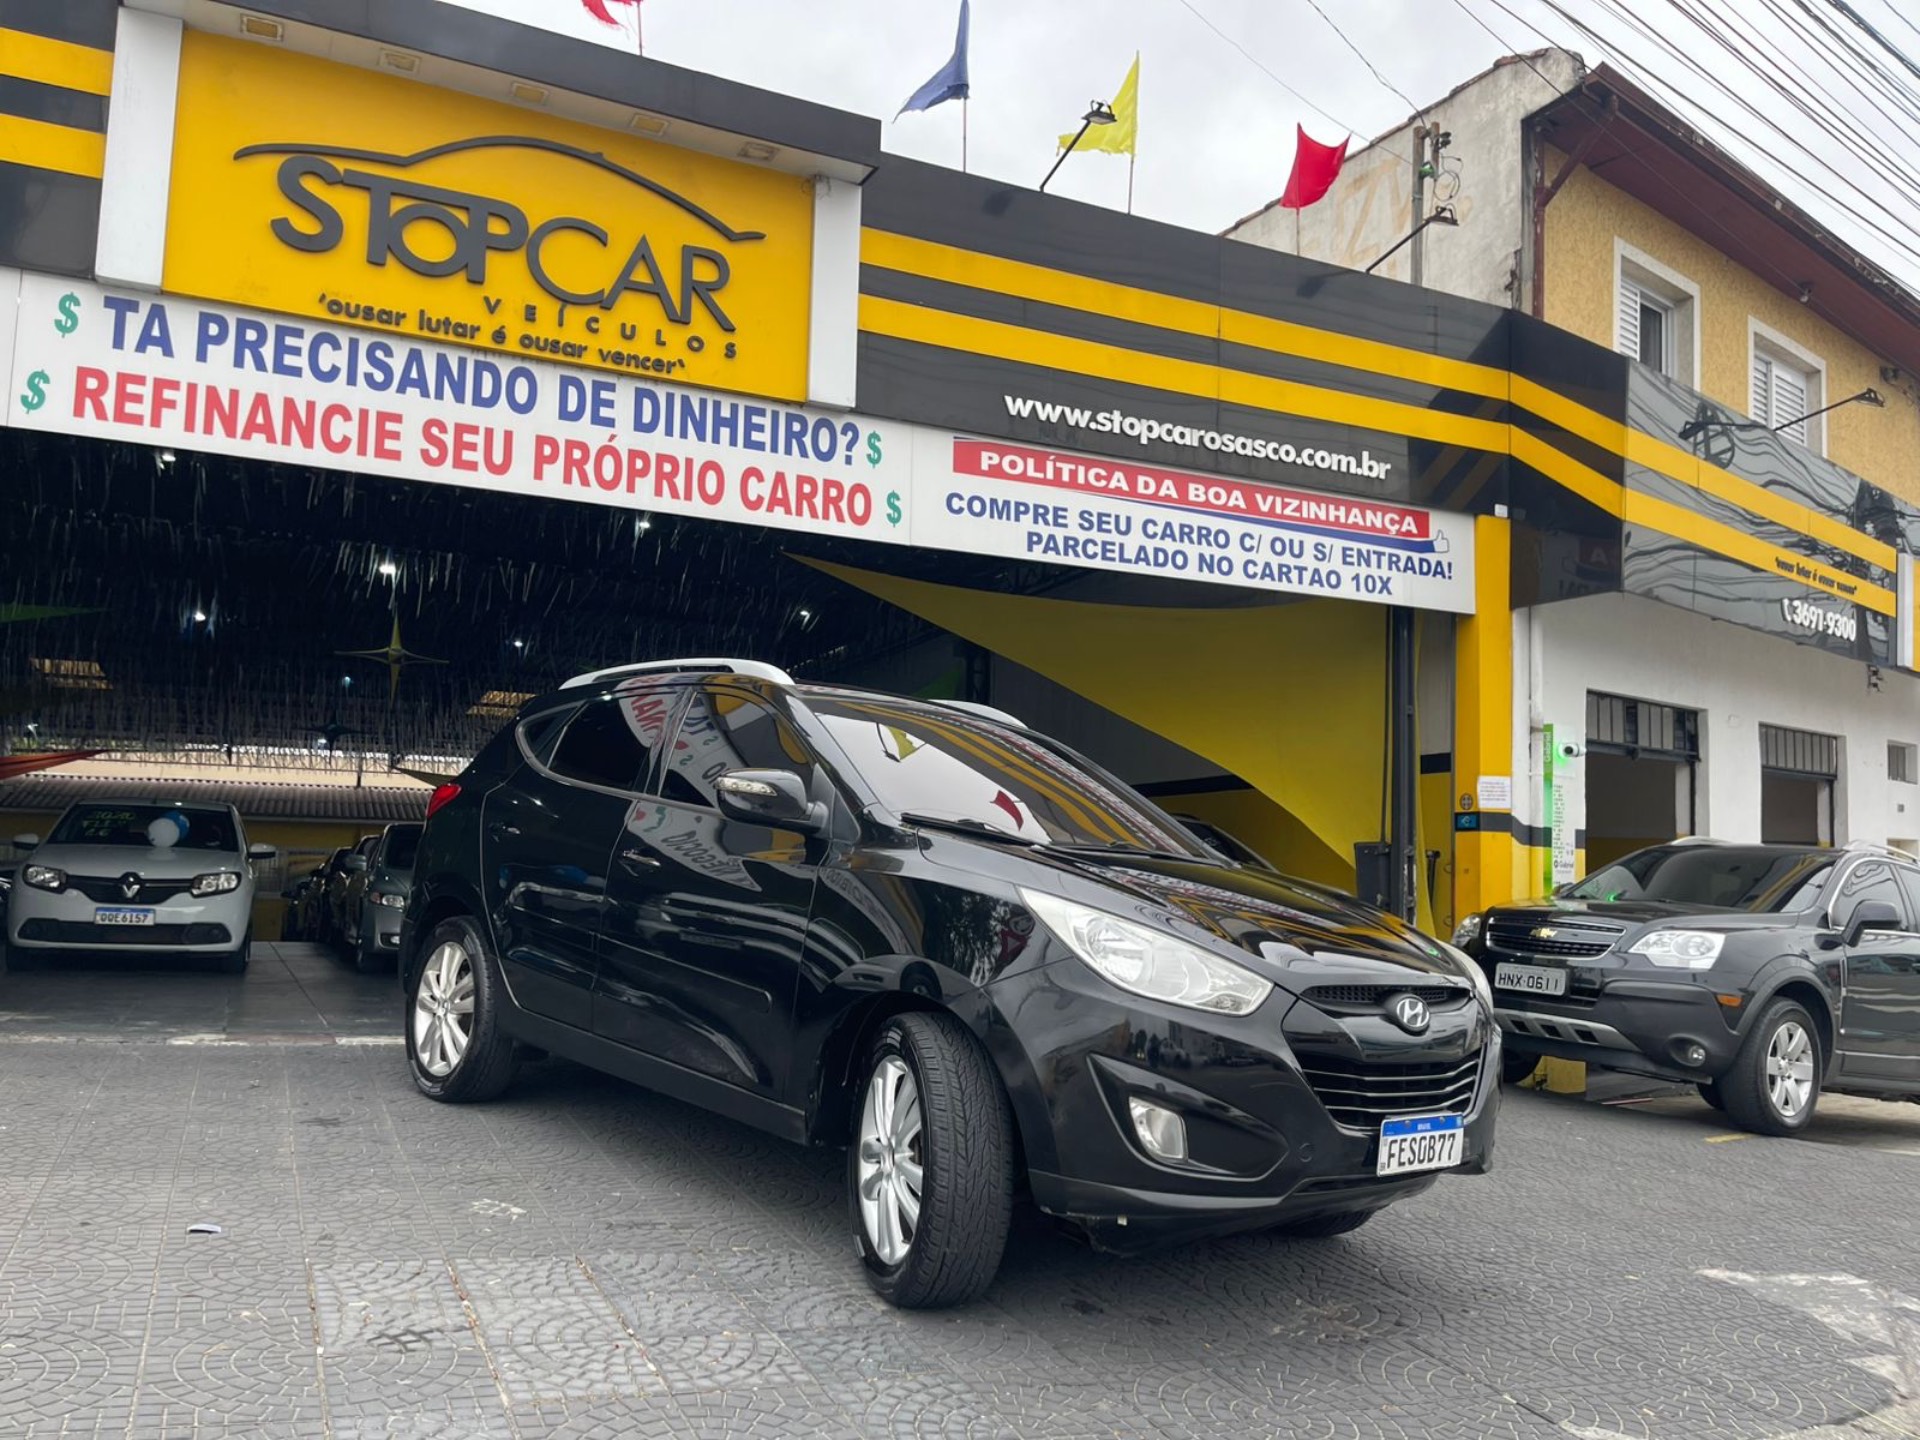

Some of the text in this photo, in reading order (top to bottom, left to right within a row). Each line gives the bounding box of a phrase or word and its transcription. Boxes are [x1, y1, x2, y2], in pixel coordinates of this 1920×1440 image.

[270, 155, 737, 332] STOPCAR
[418, 309, 481, 340] lutar
[491, 326, 507, 344] é
[518, 333, 588, 359] ousar
[103, 295, 174, 358] TA
[195, 310, 538, 415] PRECISANDO
[558, 374, 617, 428] DE
[633, 386, 860, 466] DINHEIRO?
[73, 365, 403, 461] REFINANCIE
[420, 418, 514, 476] SEU
[533, 433, 725, 506] PRÓPRIO
[740, 466, 872, 526] CARRO
[1004, 394, 1391, 480] www.stopcarosasco.com.br
[980, 450, 1418, 535] POLÍTICA DA BOA VIZINHANÇA
[946, 492, 1453, 580] COMPRE SEU CARRO C/ OU S/ ENTRADA!
[1026, 530, 1393, 595] PARCELADO NO CARTAO 10X
[1792, 599, 1856, 642] 3691-9300
